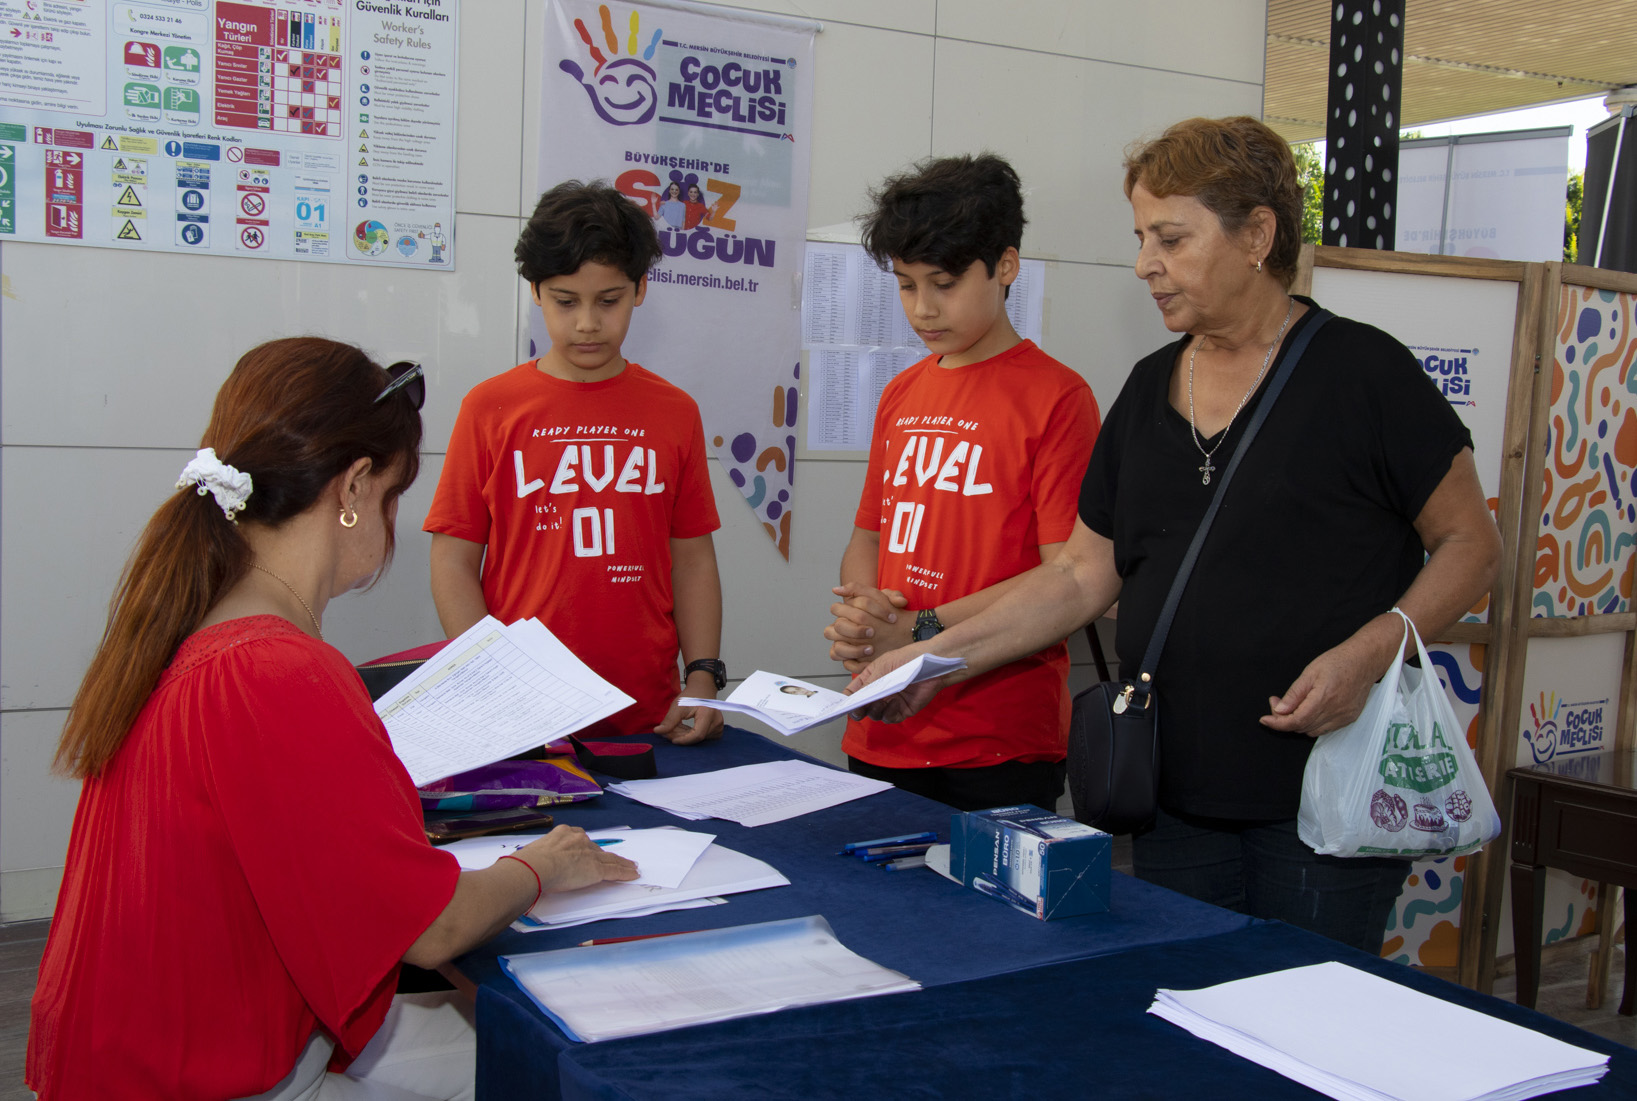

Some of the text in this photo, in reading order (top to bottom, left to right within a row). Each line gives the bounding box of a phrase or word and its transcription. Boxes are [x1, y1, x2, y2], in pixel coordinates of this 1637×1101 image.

[356, 0, 449, 22] Güvenlik Kuralları
[130, 28, 192, 40] Kongre Merkezi Yönetim
[218, 17, 257, 33] Yangın
[223, 32, 252, 43] Türleri
[374, 33, 432, 49] Safety Rules
[689, 44, 709, 52] MERSİN
[710, 47, 742, 57] BÜYÜKŞEHİR
[743, 53, 770, 62] BELEDİYESİ
[680, 56, 782, 95] ÇOCUK
[76, 121, 104, 130] Uyulması
[105, 124, 128, 133] Zorunlu
[128, 126, 146, 135] Sağlık
[156, 128, 180, 138] Güvenlik
[222, 135, 242, 143] Kodları
[625, 151, 730, 174] BÜYÜKŞEHİR'DE
[614, 169, 742, 232] SÖZ
[296, 202, 325, 222] 01
[658, 226, 776, 268] ÜĞÜN
[646, 268, 759, 292] clisi.mersin.bel.tr
[1416, 355, 1468, 376] CUK
[532, 425, 645, 437] READY PLAYER ONE
[896, 416, 979, 431] READY PLAYER ONE
[514, 445, 665, 498] LEVEL
[535, 503, 557, 514] let's
[536, 517, 562, 531] do it!
[1566, 707, 1603, 730] ÇOCUK
[1002, 834, 1010, 867] BÜRO
